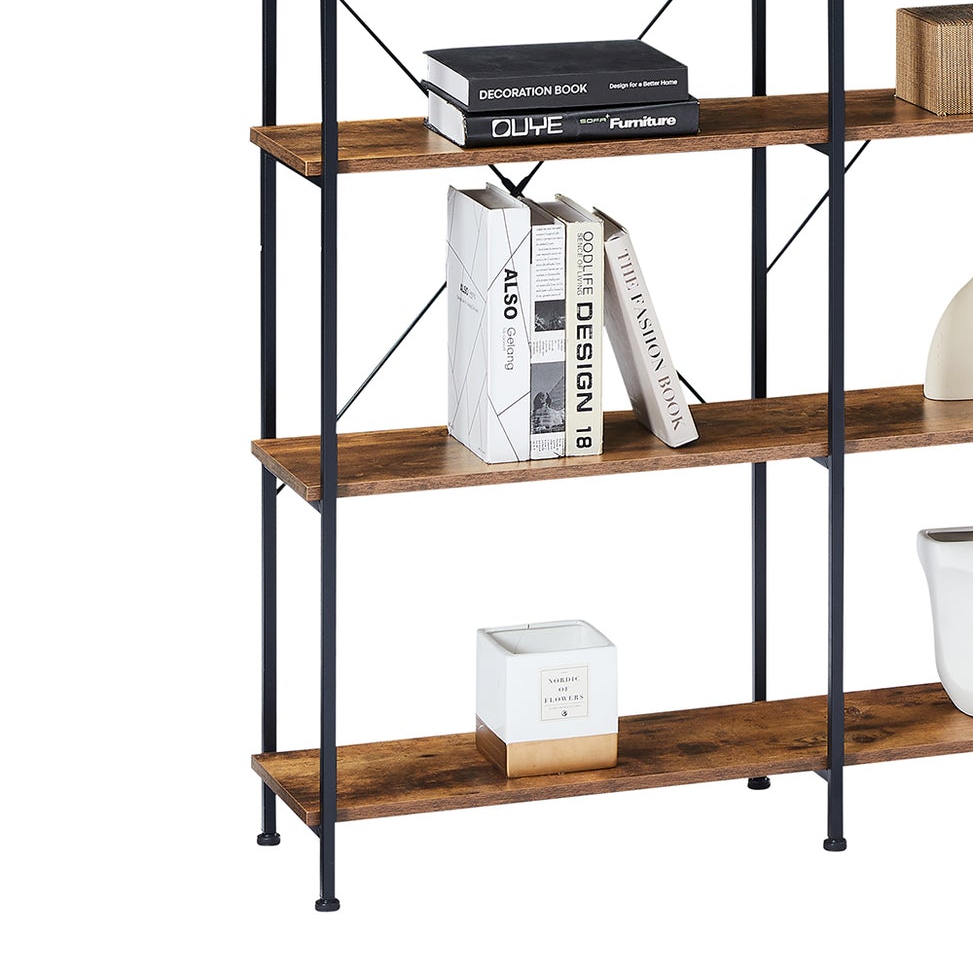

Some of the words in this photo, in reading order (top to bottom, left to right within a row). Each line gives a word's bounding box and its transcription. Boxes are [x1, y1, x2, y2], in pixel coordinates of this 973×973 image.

[480, 86, 551, 100] DECORATION
[555, 84, 588, 95] BOOK
[610, 116, 677, 129] Furniture
[577, 259, 583, 268] OF
[504, 268, 518, 320] ALSO
[505, 327, 516, 370] Gelang
[618, 249, 639, 291] THE
[631, 293, 666, 372] FASHION
[658, 376, 685, 431] BOOK
[576, 302, 593, 412] DESIGN
[576, 426, 592, 449] 18
[544, 694, 584, 703] FLOWERS
